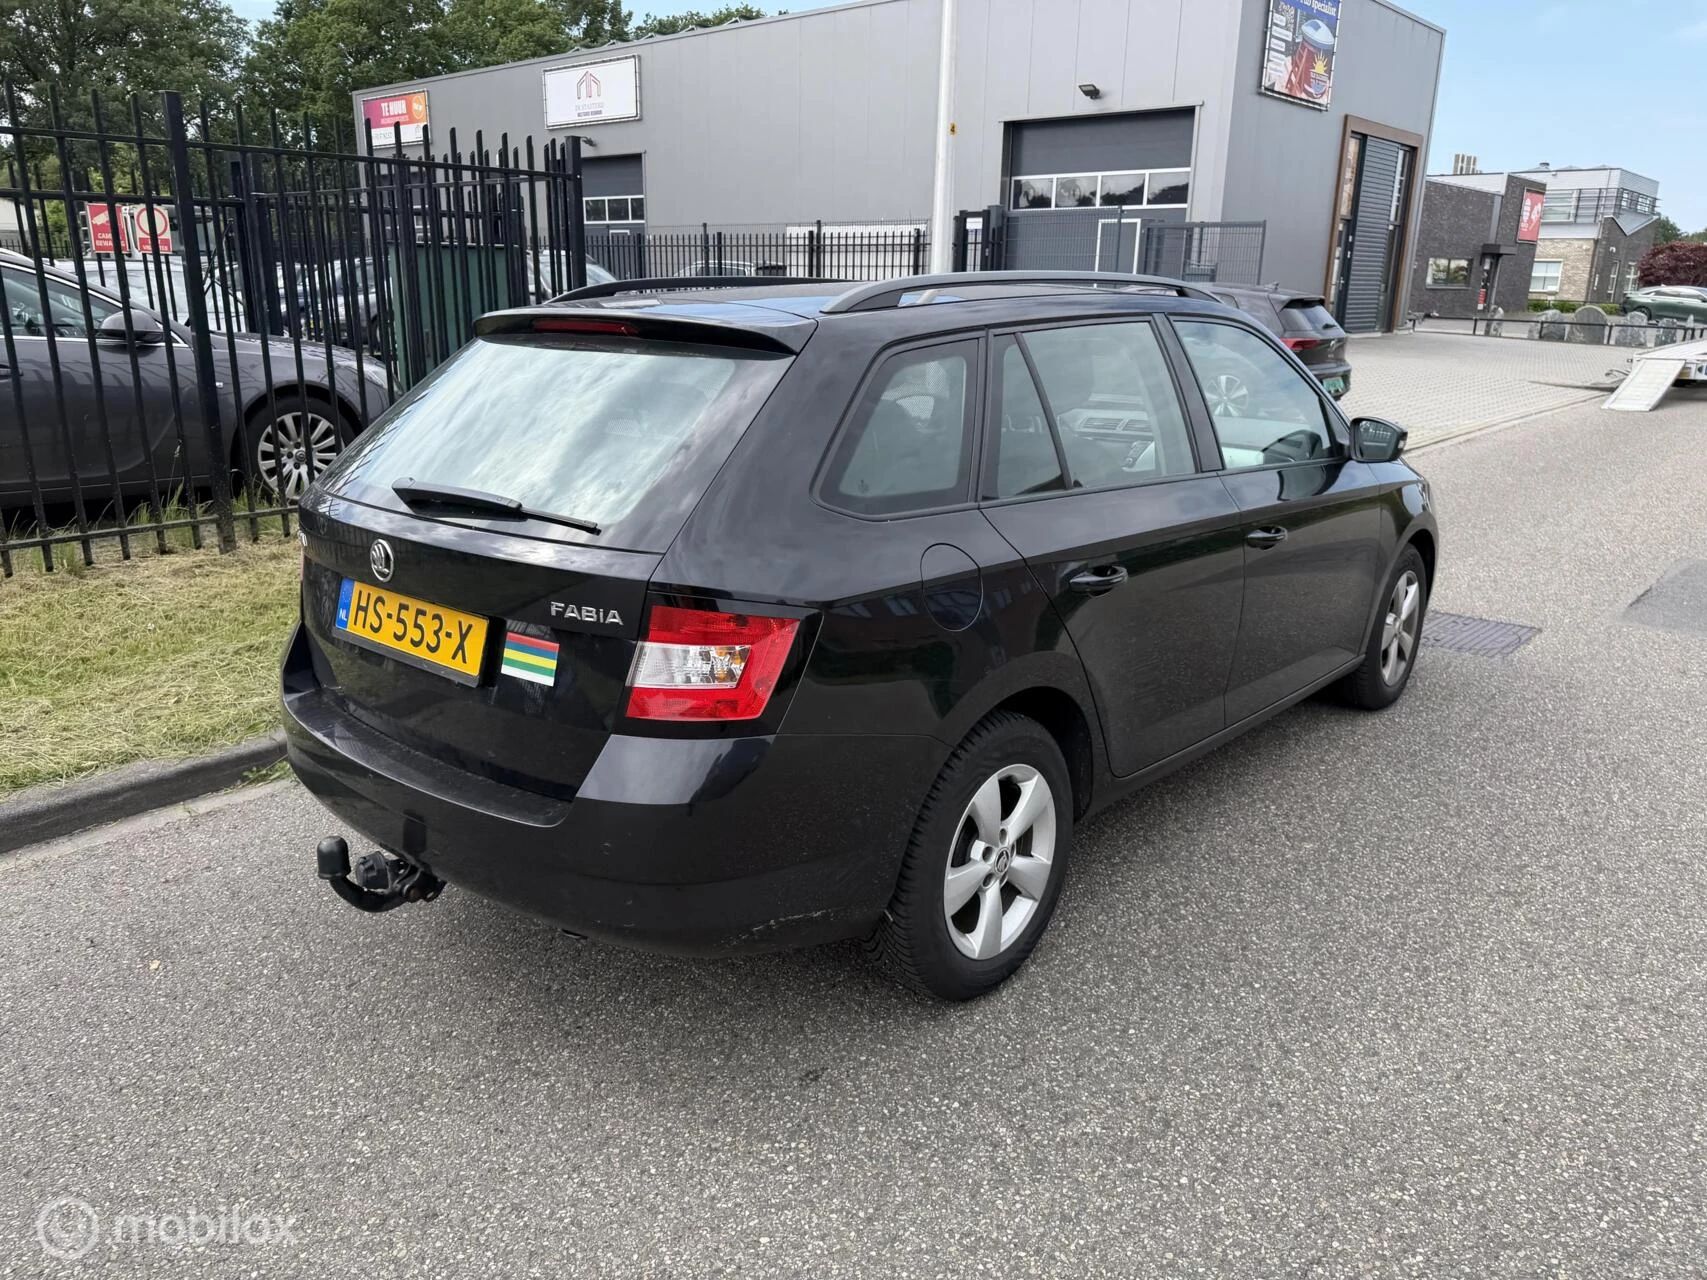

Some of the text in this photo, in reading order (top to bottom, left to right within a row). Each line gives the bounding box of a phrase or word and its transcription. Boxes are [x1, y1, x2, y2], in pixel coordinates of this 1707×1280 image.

[381, 102, 389, 117] TE
[95, 239, 126, 247] BEWAG
[338, 607, 348, 621] NL
[550, 601, 624, 626] FABIA
[353, 589, 473, 664] HS-553-X
